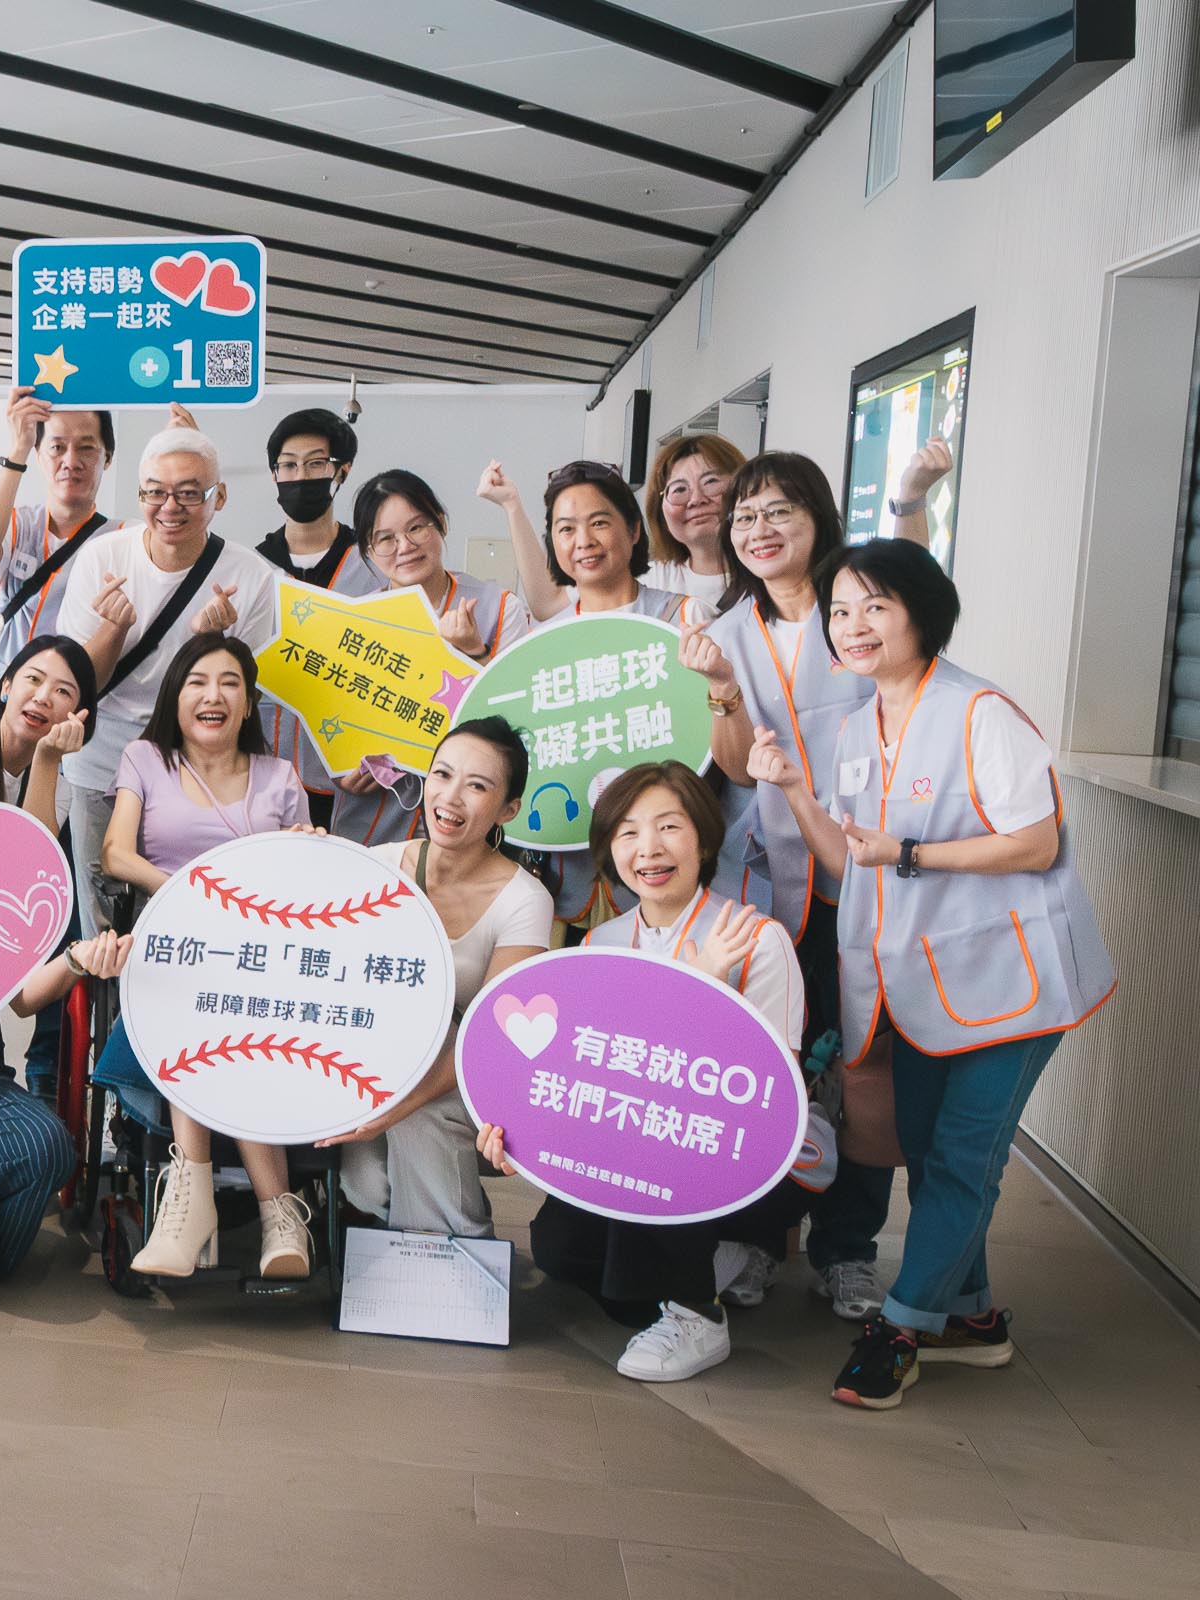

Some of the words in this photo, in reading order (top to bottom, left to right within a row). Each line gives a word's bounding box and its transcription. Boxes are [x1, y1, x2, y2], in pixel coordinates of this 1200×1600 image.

[32, 266, 143, 296] 支持弱勢
[32, 302, 171, 331] 企業一起來
[280, 638, 445, 737] 不管光亮在哪裡
[487, 642, 669, 713] 一起聽球
[522, 701, 674, 772] 礙共融
[195, 992, 375, 1029] 視障聽球賽活動
[538, 1151, 673, 1201] 愛無限公益慈善發展協會
